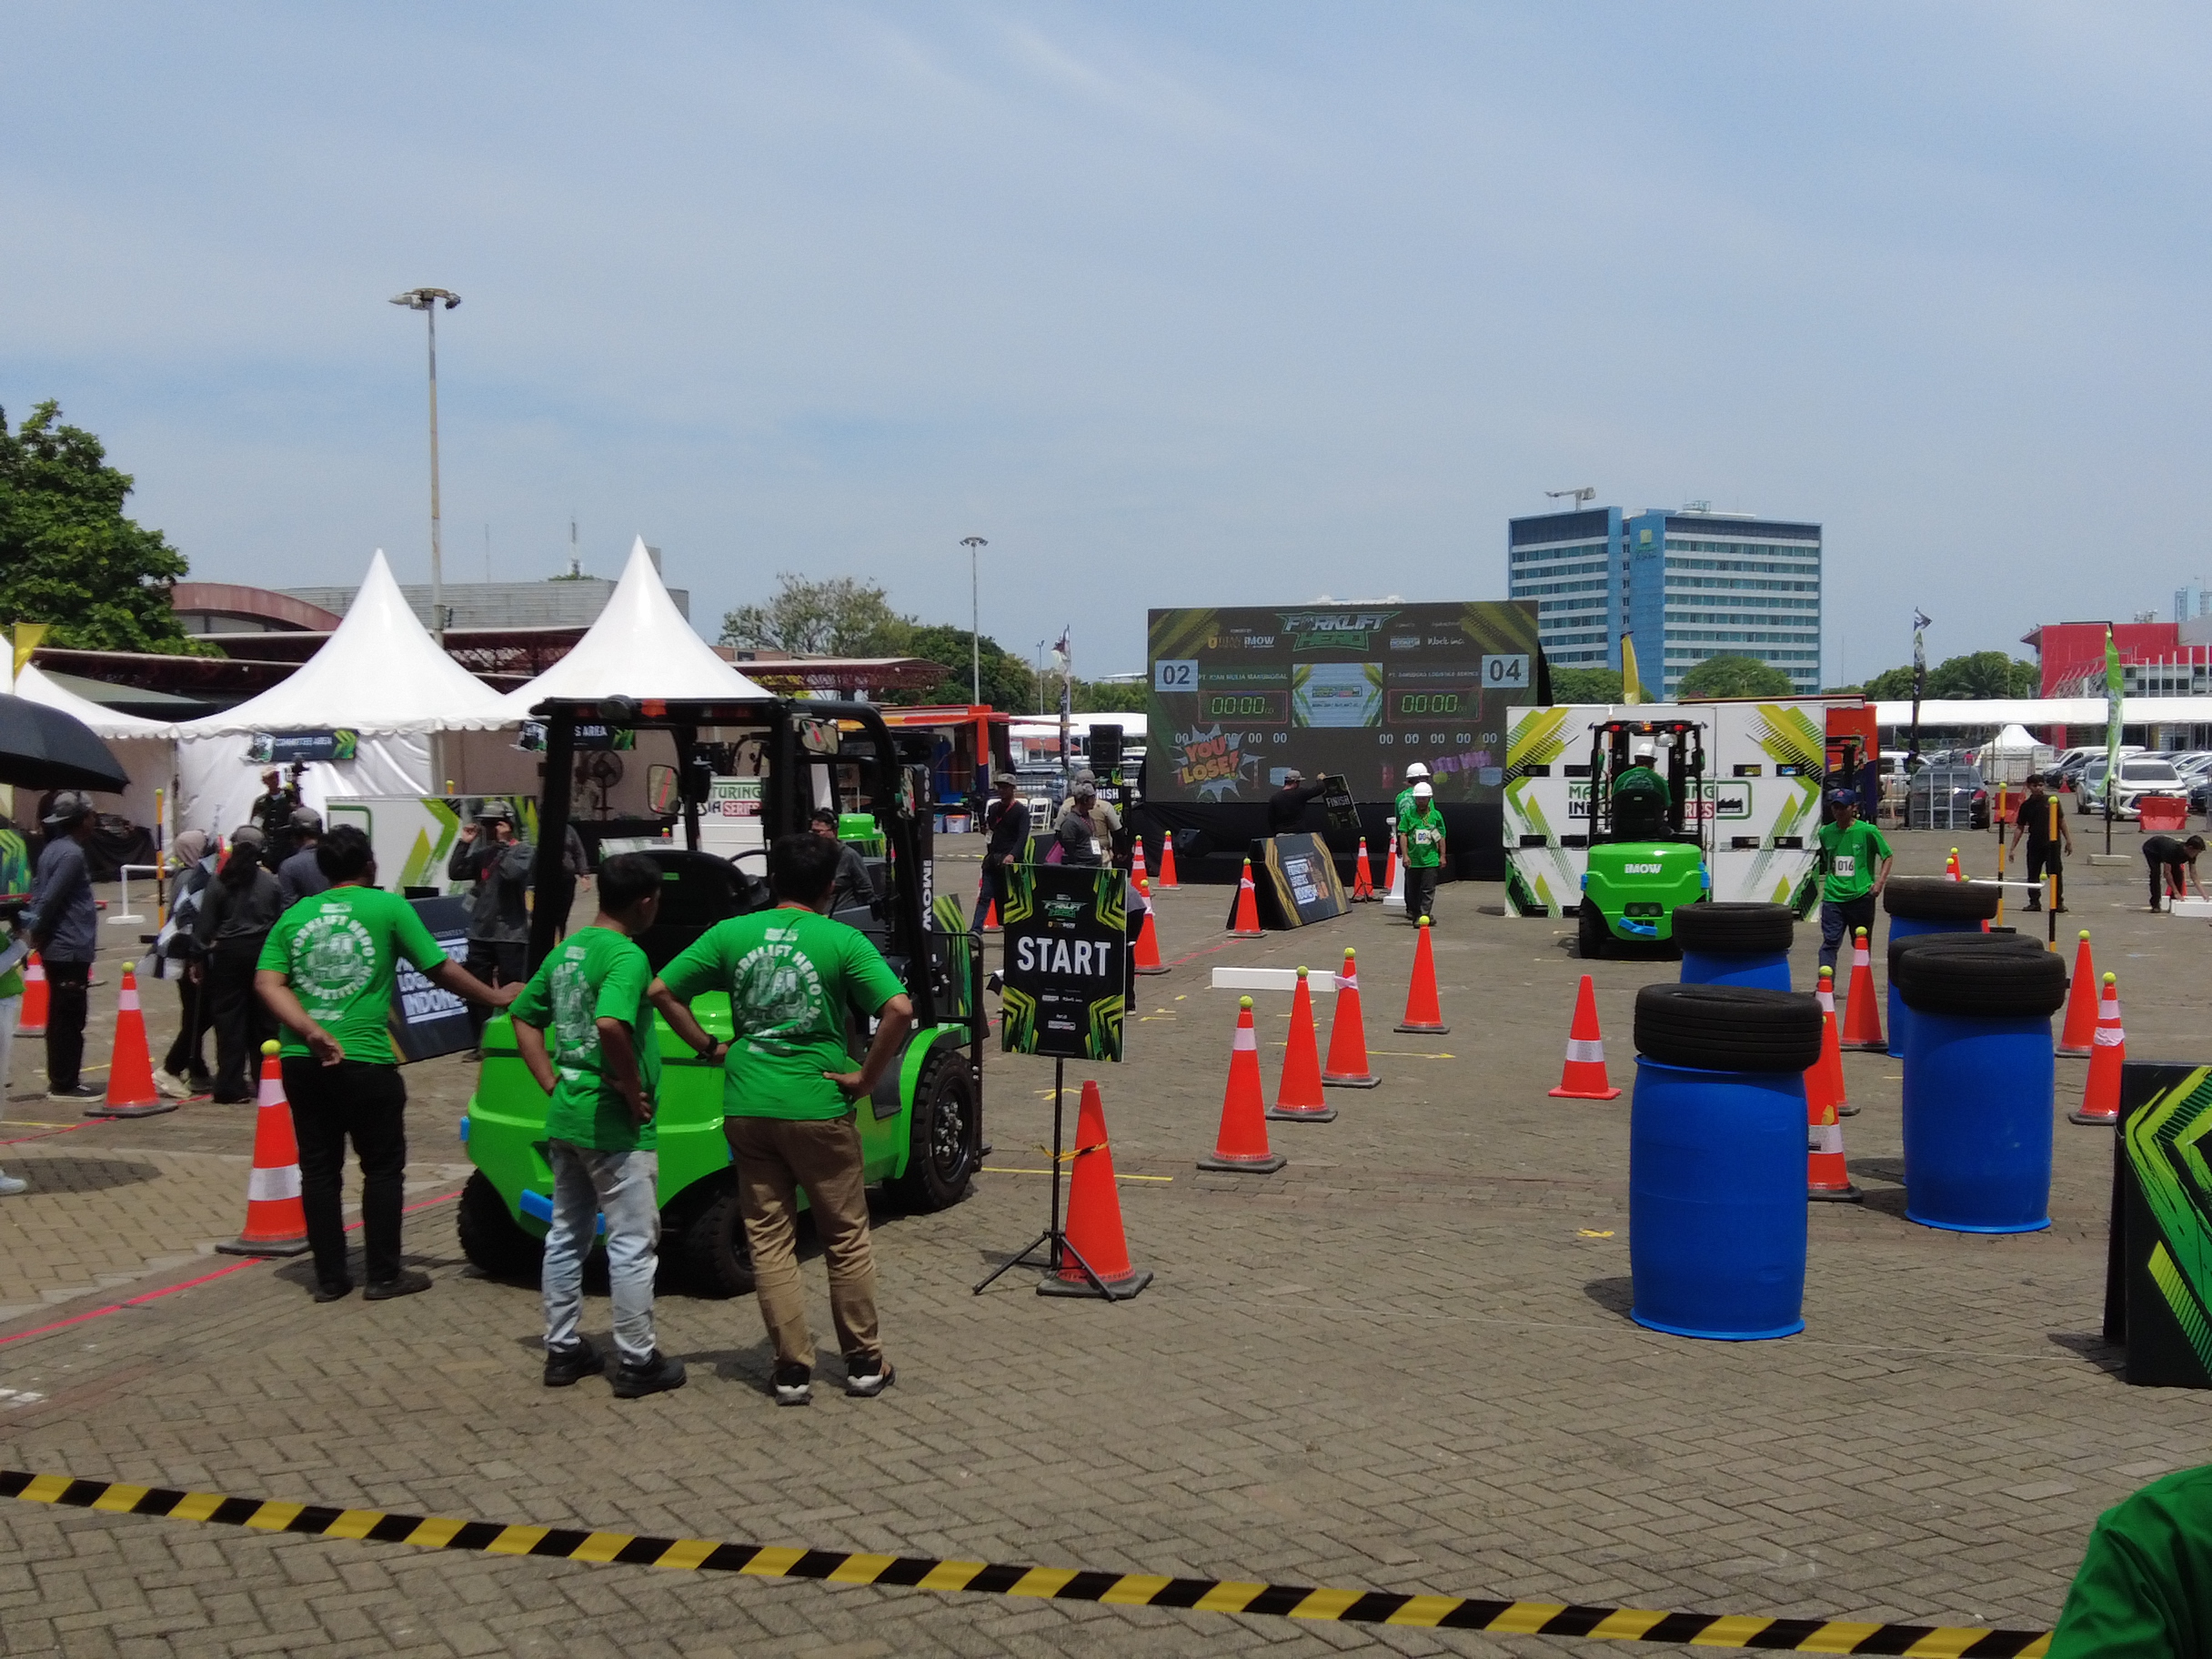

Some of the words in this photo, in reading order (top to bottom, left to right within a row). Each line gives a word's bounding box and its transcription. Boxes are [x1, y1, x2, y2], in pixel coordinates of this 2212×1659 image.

[1162, 665, 1191, 685] 02
[1489, 659, 1521, 682] 04
[583, 725, 608, 737] AREA
[1248, 732, 1262, 744] 00
[1272, 732, 1288, 744] 00
[1379, 733, 1394, 745] 00
[1404, 733, 1420, 744] 00
[1430, 733, 1445, 744] 00
[1456, 733, 1472, 744] 00
[1483, 732, 1498, 744] 00
[1185, 736, 1227, 762] YOU
[1182, 750, 1240, 784] LOSE!
[1325, 794, 1352, 809] FINISH
[1624, 863, 1664, 874] IMOW
[1836, 860, 1855, 871] 016
[921, 860, 932, 932] IMOW
[1016, 935, 1111, 977] START
